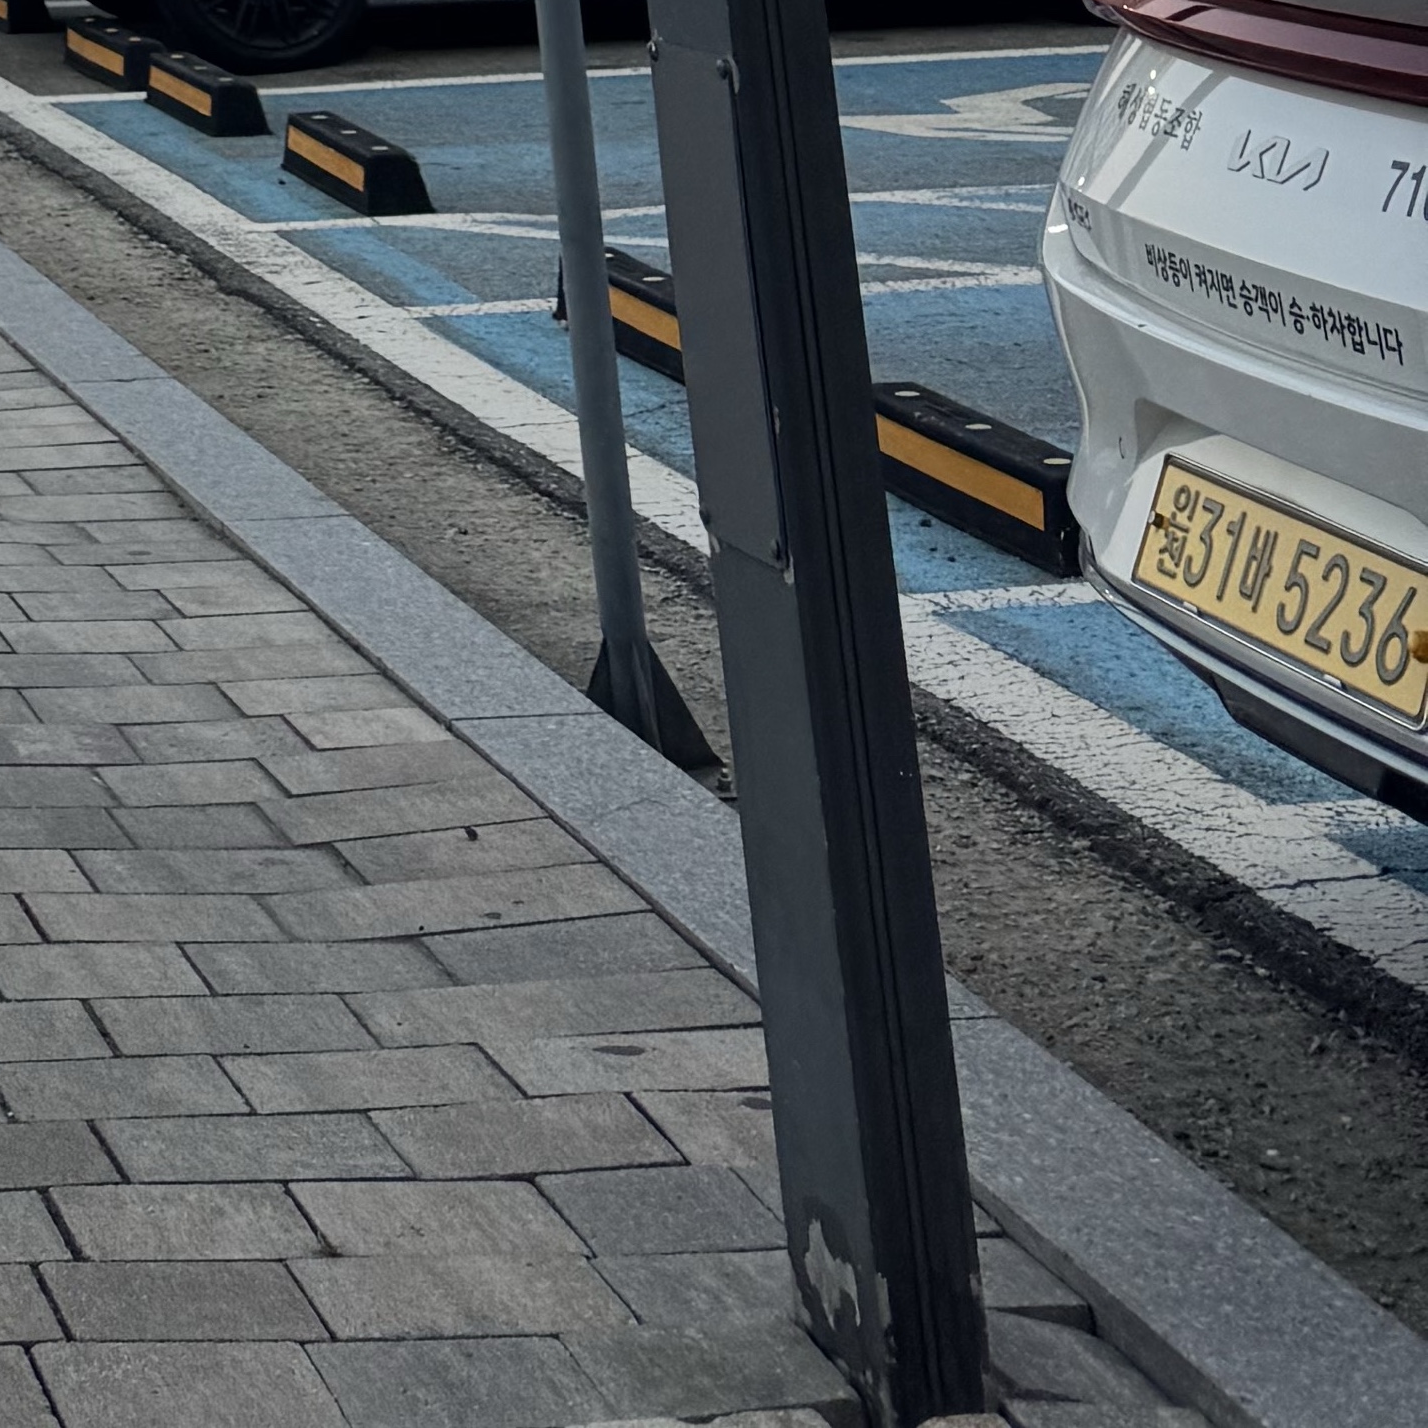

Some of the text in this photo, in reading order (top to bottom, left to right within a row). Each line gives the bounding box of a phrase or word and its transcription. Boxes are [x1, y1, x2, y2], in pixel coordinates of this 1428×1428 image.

[1381, 159, 1428, 222] 71
[1145, 243, 1194, 293] 비상등이
[1194, 263, 1238, 310] 켜지면
[1239, 279, 1286, 327] 승객이
[1276, 538, 1418, 686] 5236
